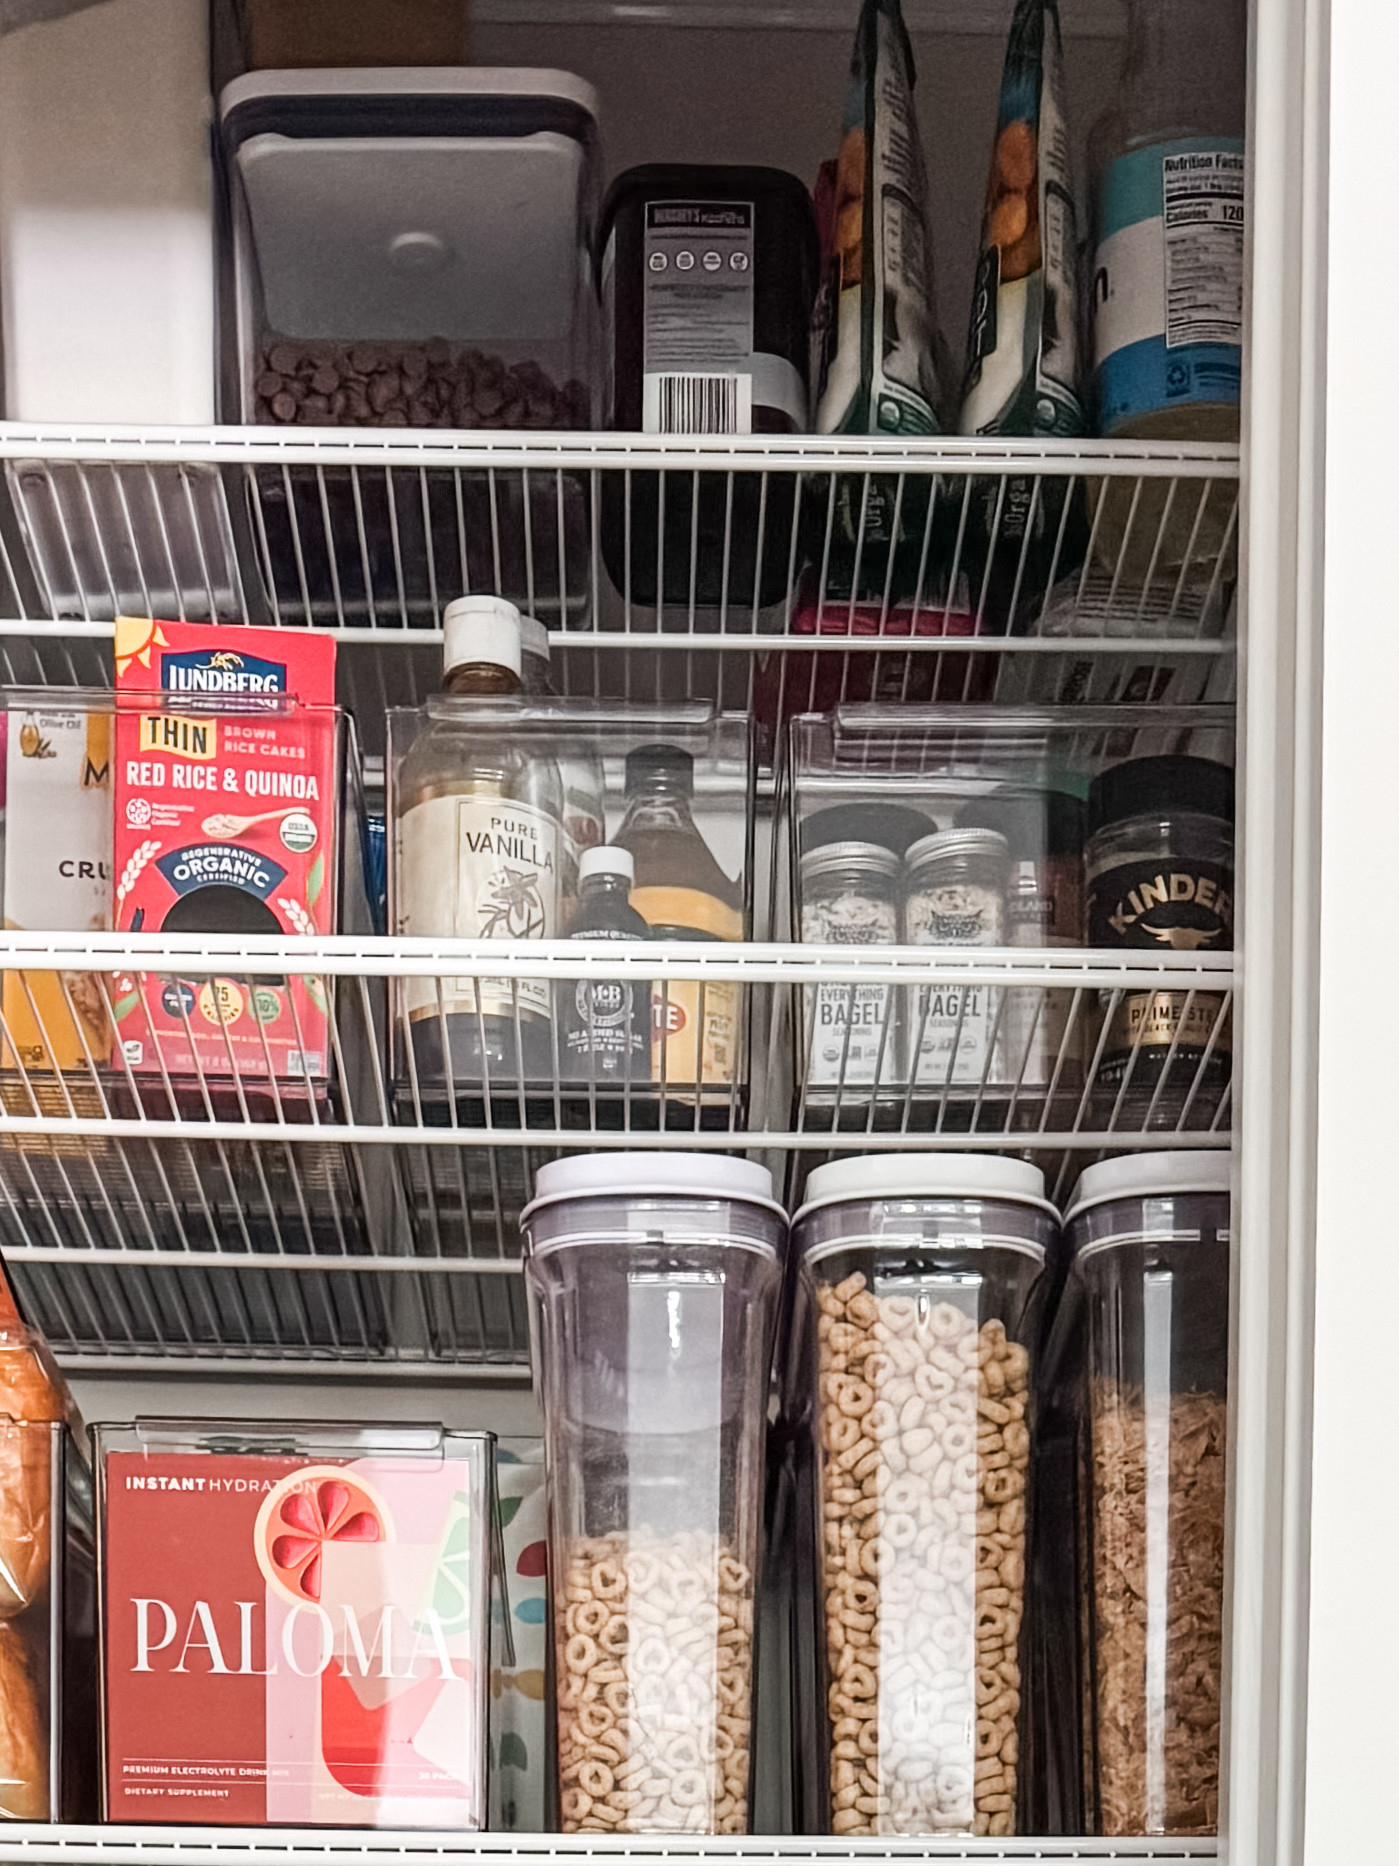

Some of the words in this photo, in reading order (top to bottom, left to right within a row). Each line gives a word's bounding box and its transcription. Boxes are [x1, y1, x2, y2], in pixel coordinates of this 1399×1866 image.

[147, 717, 208, 754] THIN
[224, 726, 276, 740] BROWN
[224, 741, 256, 754] RICE
[260, 744, 306, 759] CAKES
[127, 761, 165, 787] RED
[173, 763, 218, 791] RICE
[223, 768, 239, 793] &
[245, 769, 319, 800] QUINOA
[491, 817, 538, 841] PURE
[182, 842, 262, 867] REGENERATIVE
[466, 832, 553, 874] VANILLA
[173, 855, 270, 889] ORGANIC
[821, 1002, 884, 1026] BAGEL
[126, 1477, 206, 1492] INSTANT
[209, 1478, 317, 1495] HYDRATION
[130, 1598, 466, 1681] PALOMA
[123, 1765, 168, 1775] PREMIUM
[171, 1766, 235, 1777] ELECTROLYTE
[125, 1787, 164, 1797] DIETARY
[167, 1789, 229, 1798] SUPPLEMENT
